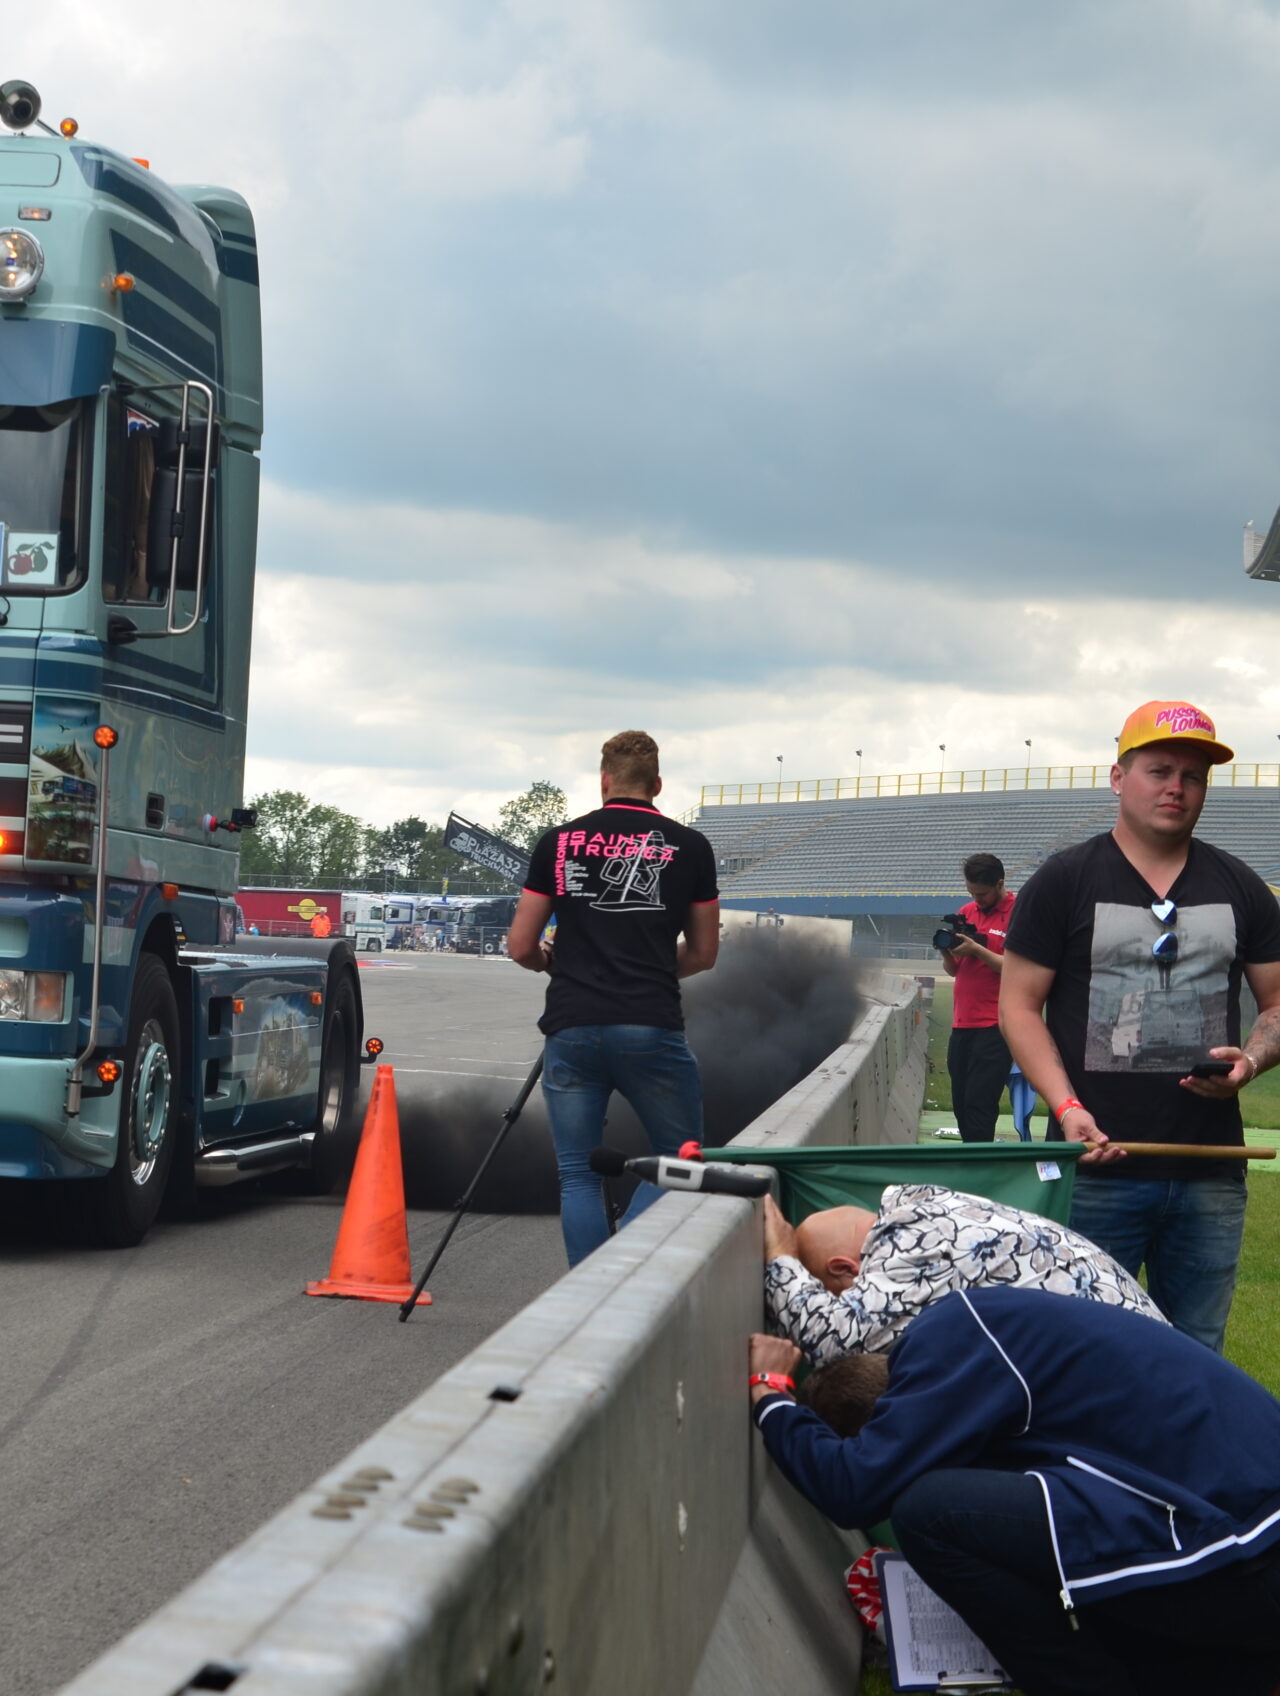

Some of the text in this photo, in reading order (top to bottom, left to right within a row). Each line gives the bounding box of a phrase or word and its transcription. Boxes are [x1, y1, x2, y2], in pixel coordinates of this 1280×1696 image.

[1155, 706, 1201, 729] PUSSY
[569, 830, 652, 846] SAINT
[569, 842, 675, 861] TROPEZ
[470, 851, 515, 881] TRUCKWASH
[555, 831, 569, 896] PAMPELONNE
